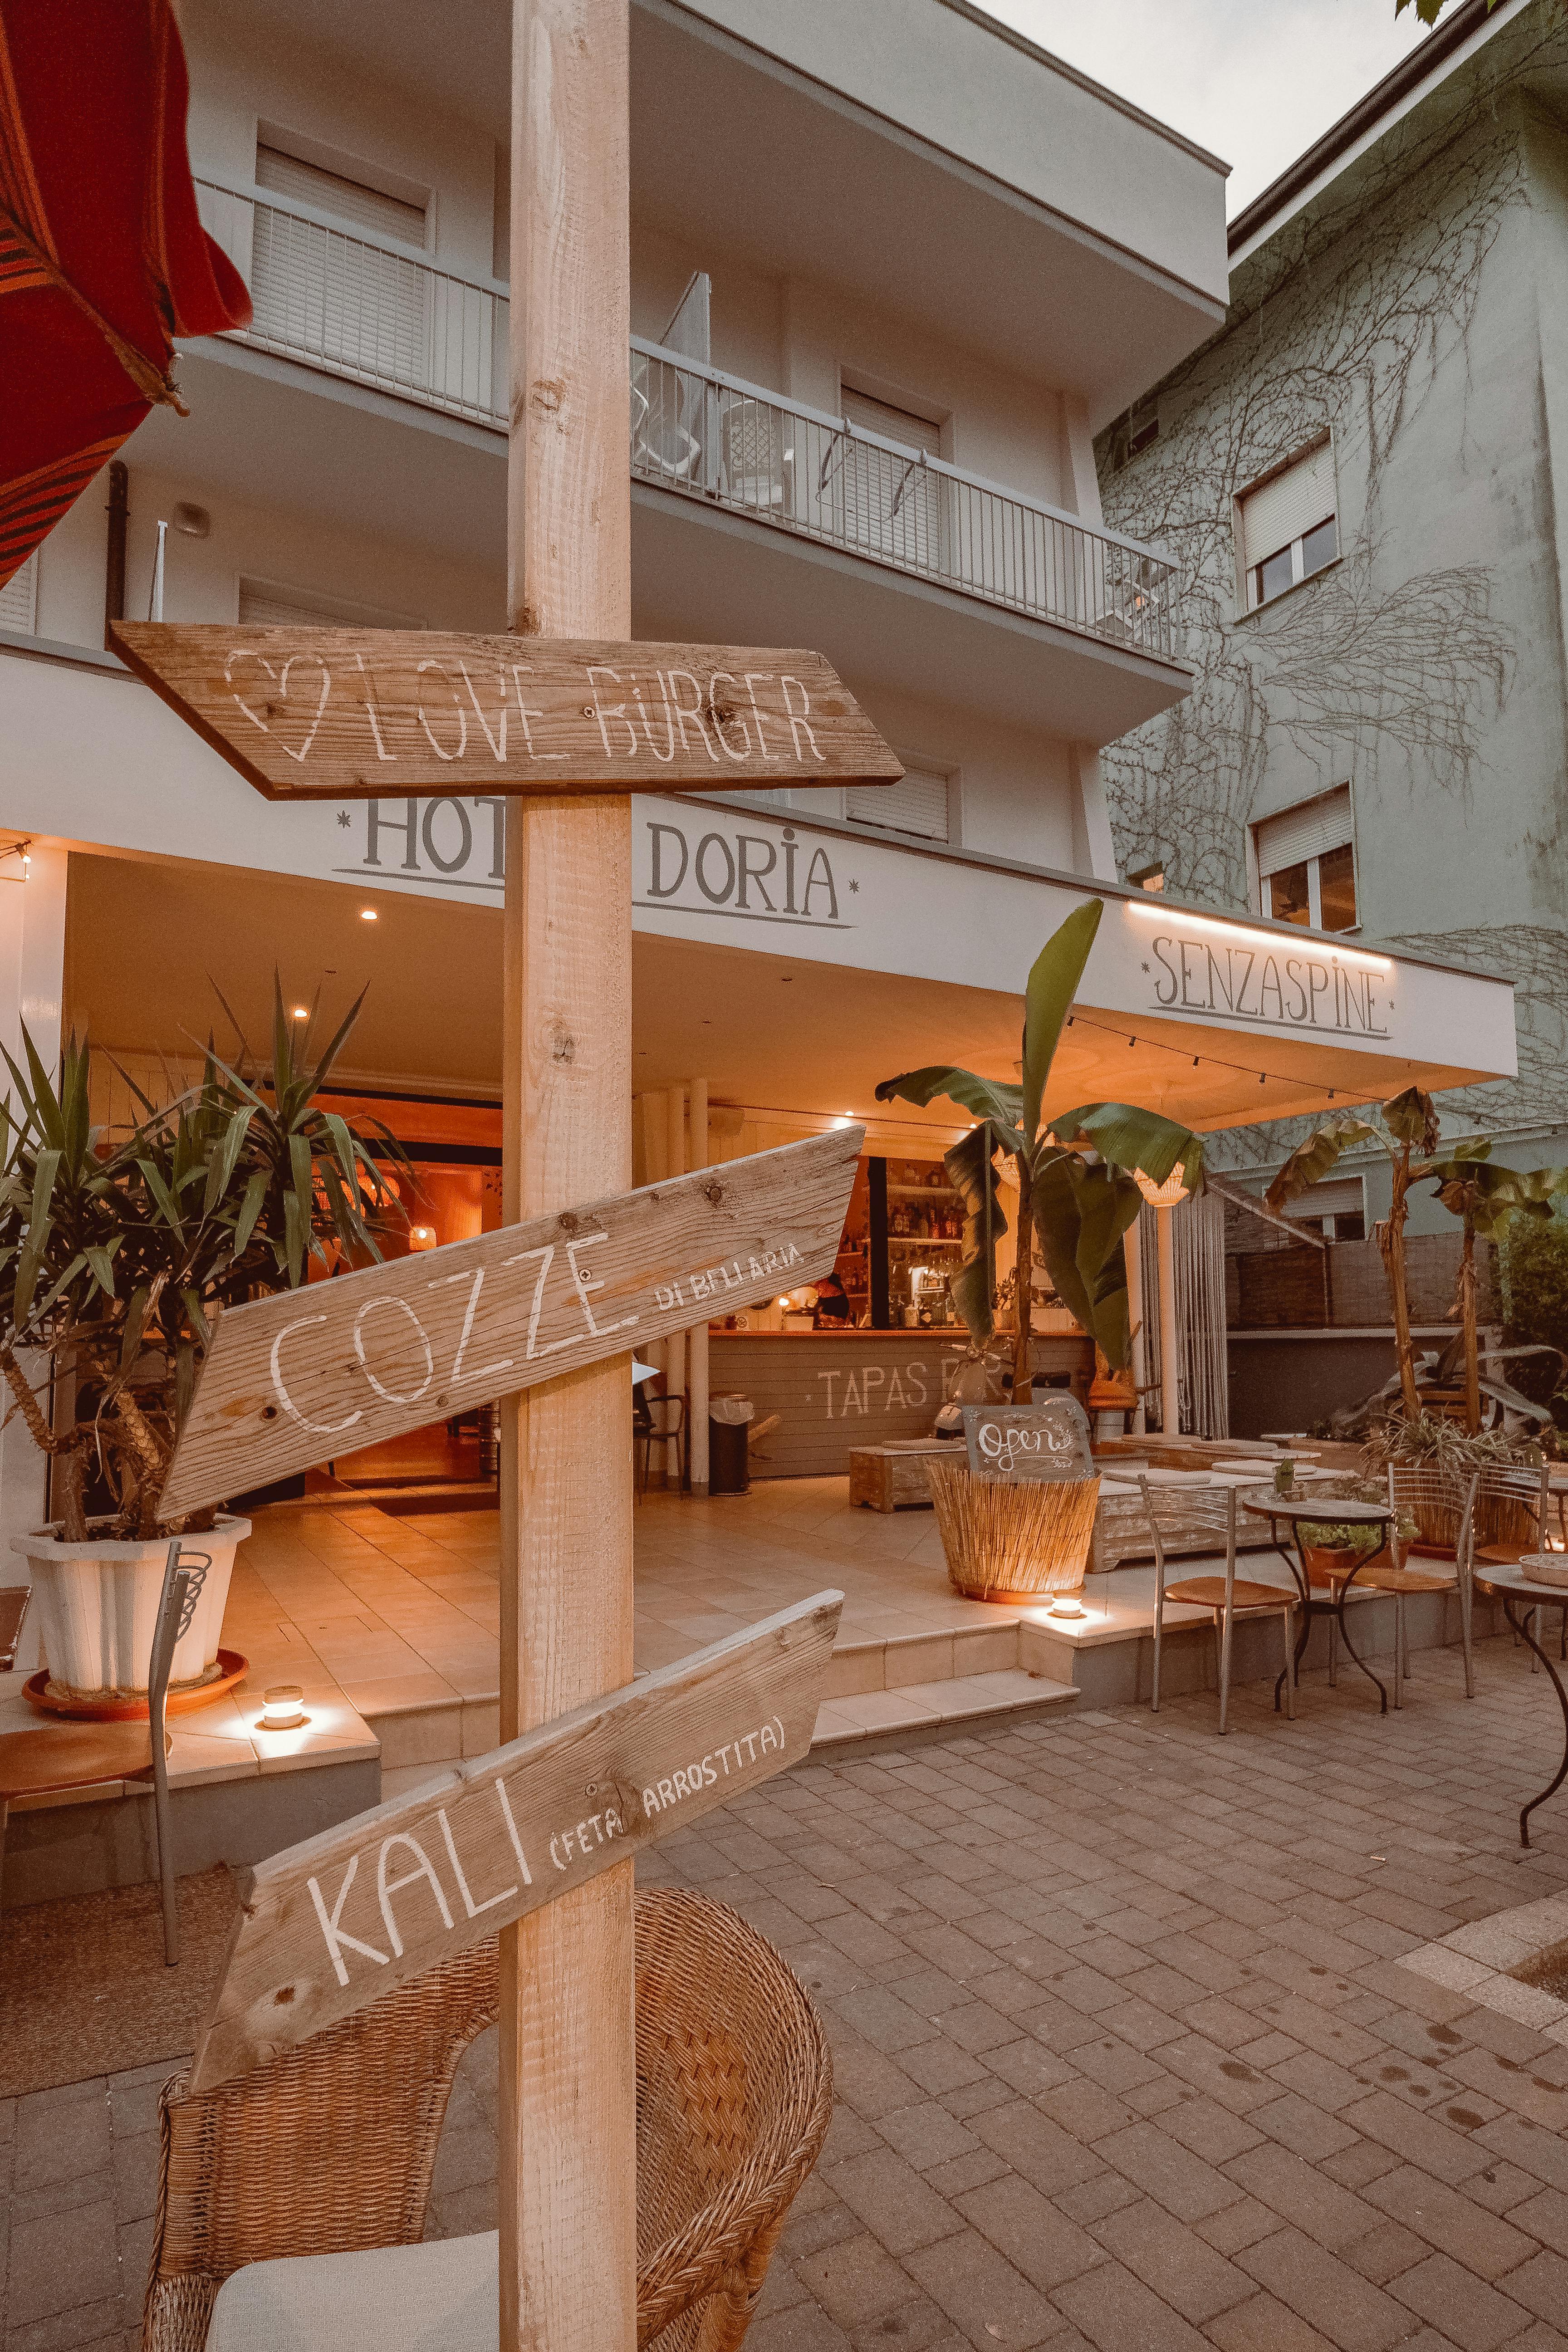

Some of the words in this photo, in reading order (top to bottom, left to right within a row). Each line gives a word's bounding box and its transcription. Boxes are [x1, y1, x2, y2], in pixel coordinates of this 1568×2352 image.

[356, 652, 571, 763] LOVE
[586, 666, 827, 762] BURGER
[363, 796, 506, 880] HOT
[270, 1231, 640, 1435] COZZE
[689, 1242, 805, 1301] BELLARIA
[817, 1360, 929, 1420] TAPAS
[978, 1423, 1061, 1471] Open
[308, 1778, 534, 1988] KALI
[549, 1807, 624, 1871] (FETA
[641, 1715, 788, 1819] ARROSTITA)
